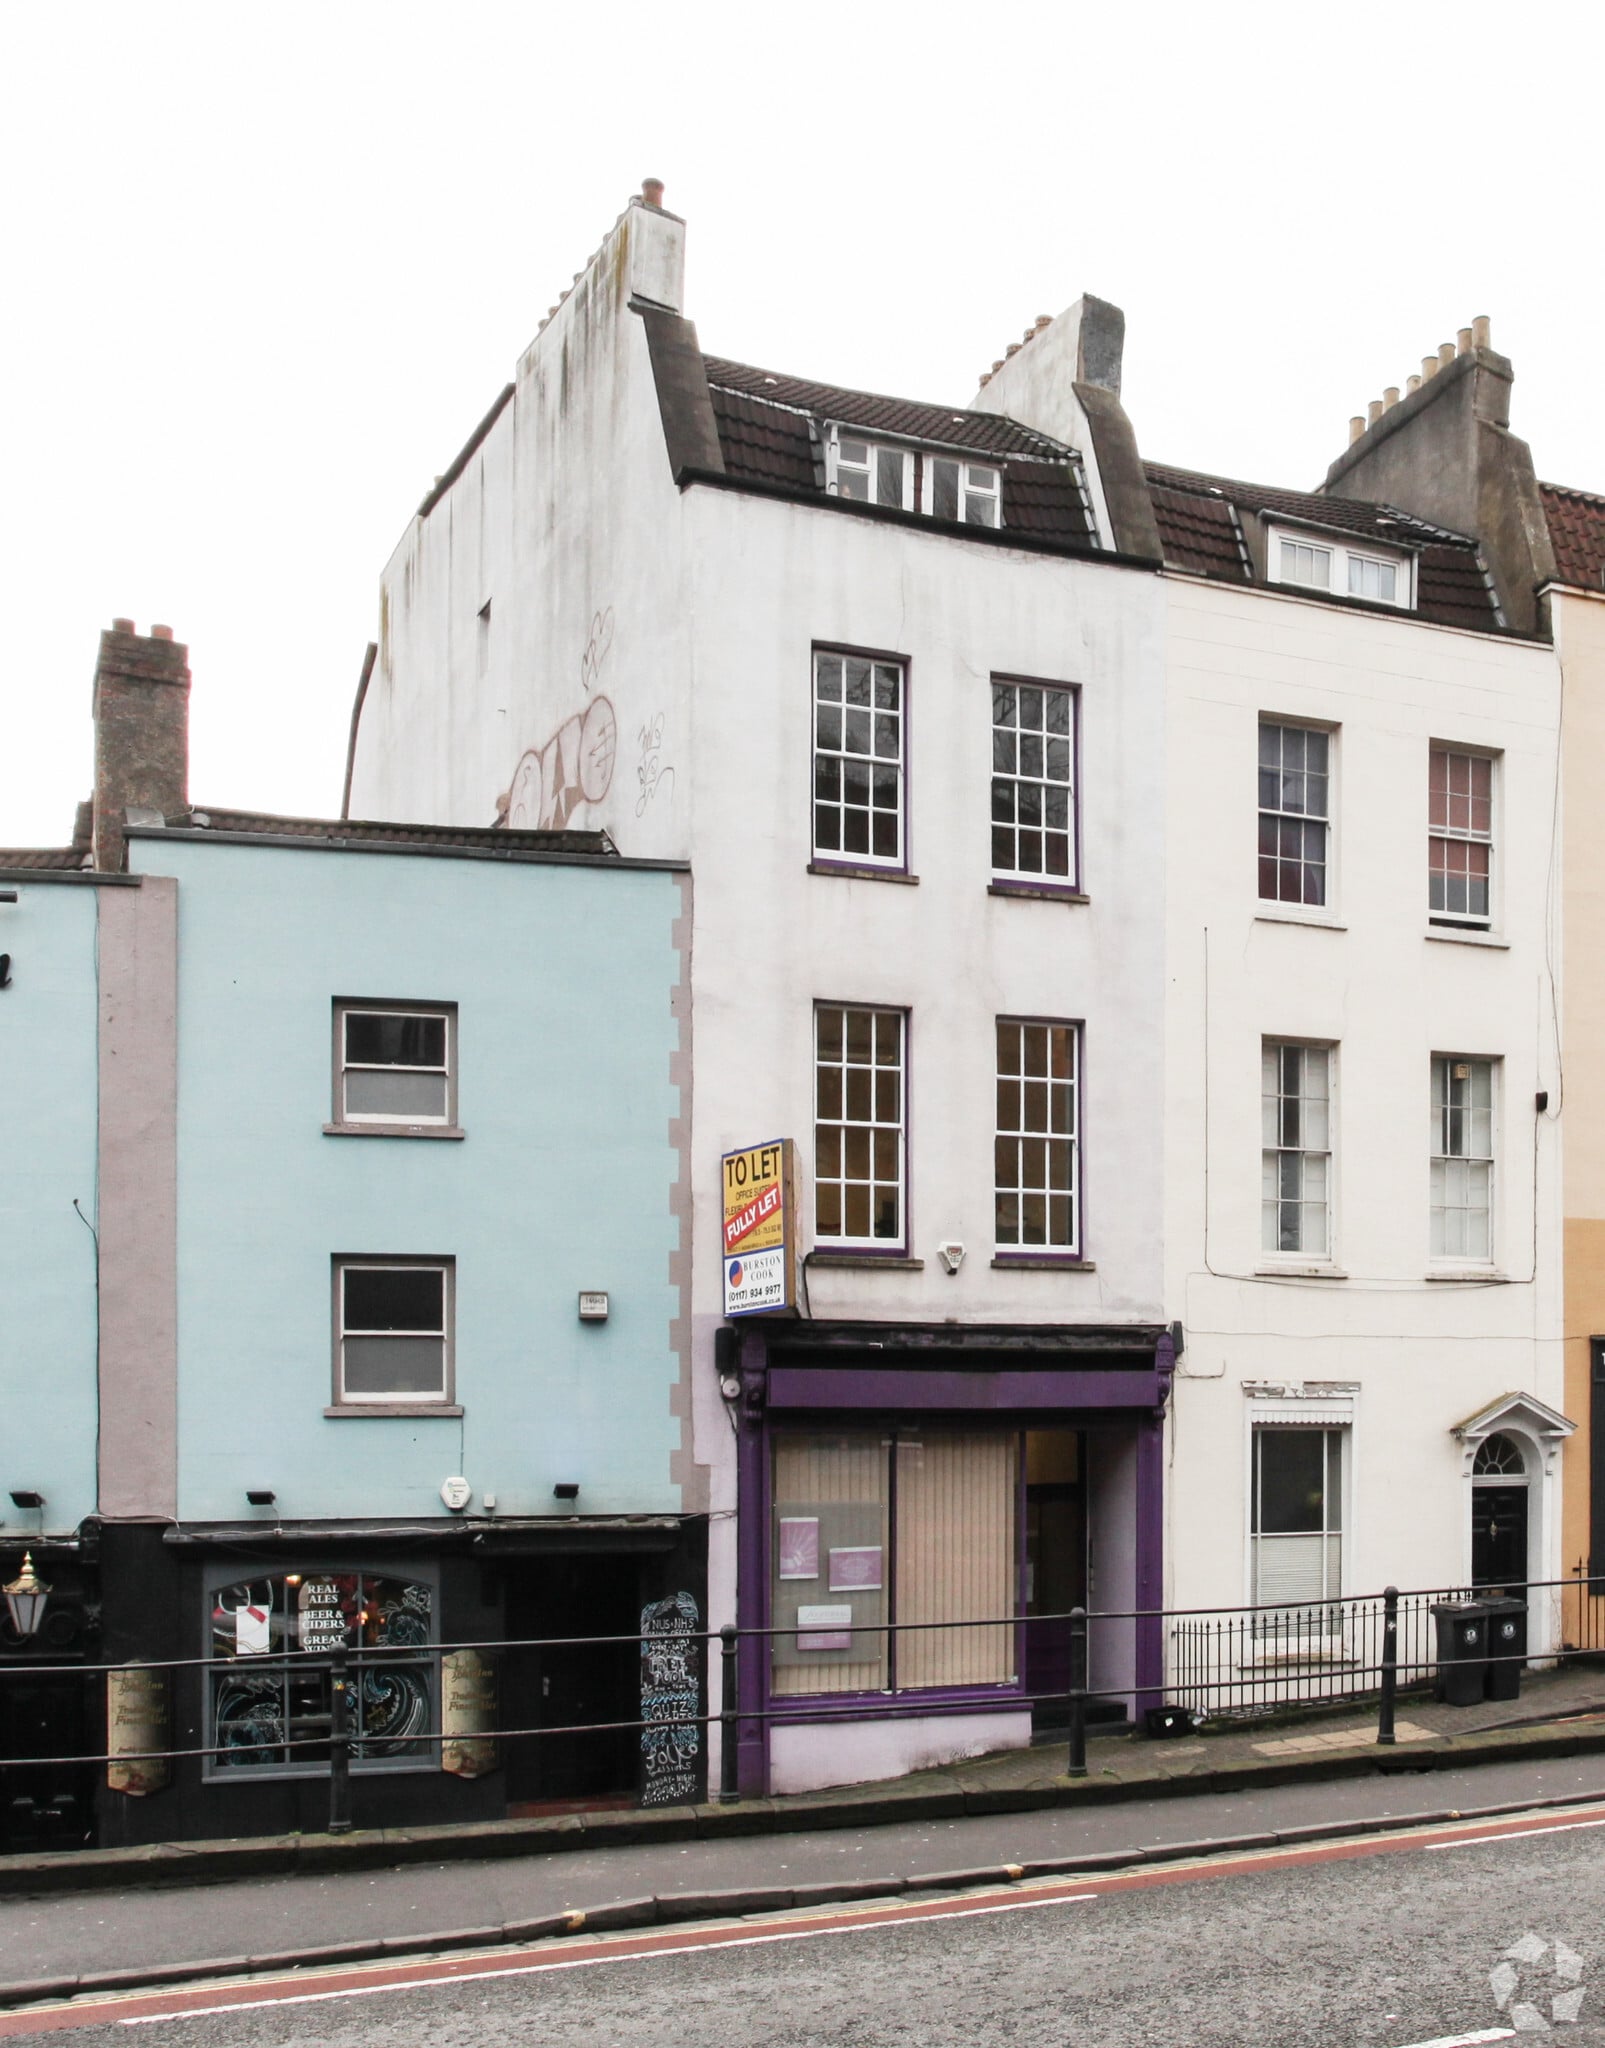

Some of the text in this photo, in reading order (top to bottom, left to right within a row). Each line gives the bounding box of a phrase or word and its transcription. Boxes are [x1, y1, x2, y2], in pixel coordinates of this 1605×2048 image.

[726, 1146, 780, 1188] TO LET
[726, 1188, 778, 1242] FULLY LET
[743, 1255, 782, 1271] BURSTON
[750, 1269, 774, 1282] COOK
[728, 1283, 781, 1303] (0117) 934 9977
[308, 1584, 340, 1594] REAL
[309, 1594, 339, 1604] ALES
[303, 1610, 344, 1619] BEER &
[303, 1619, 345, 1629] CIDERS
[303, 1635, 345, 1645] GREAT
[653, 1670, 690, 1685] POOL
[651, 1701, 689, 1716] QUIZ
